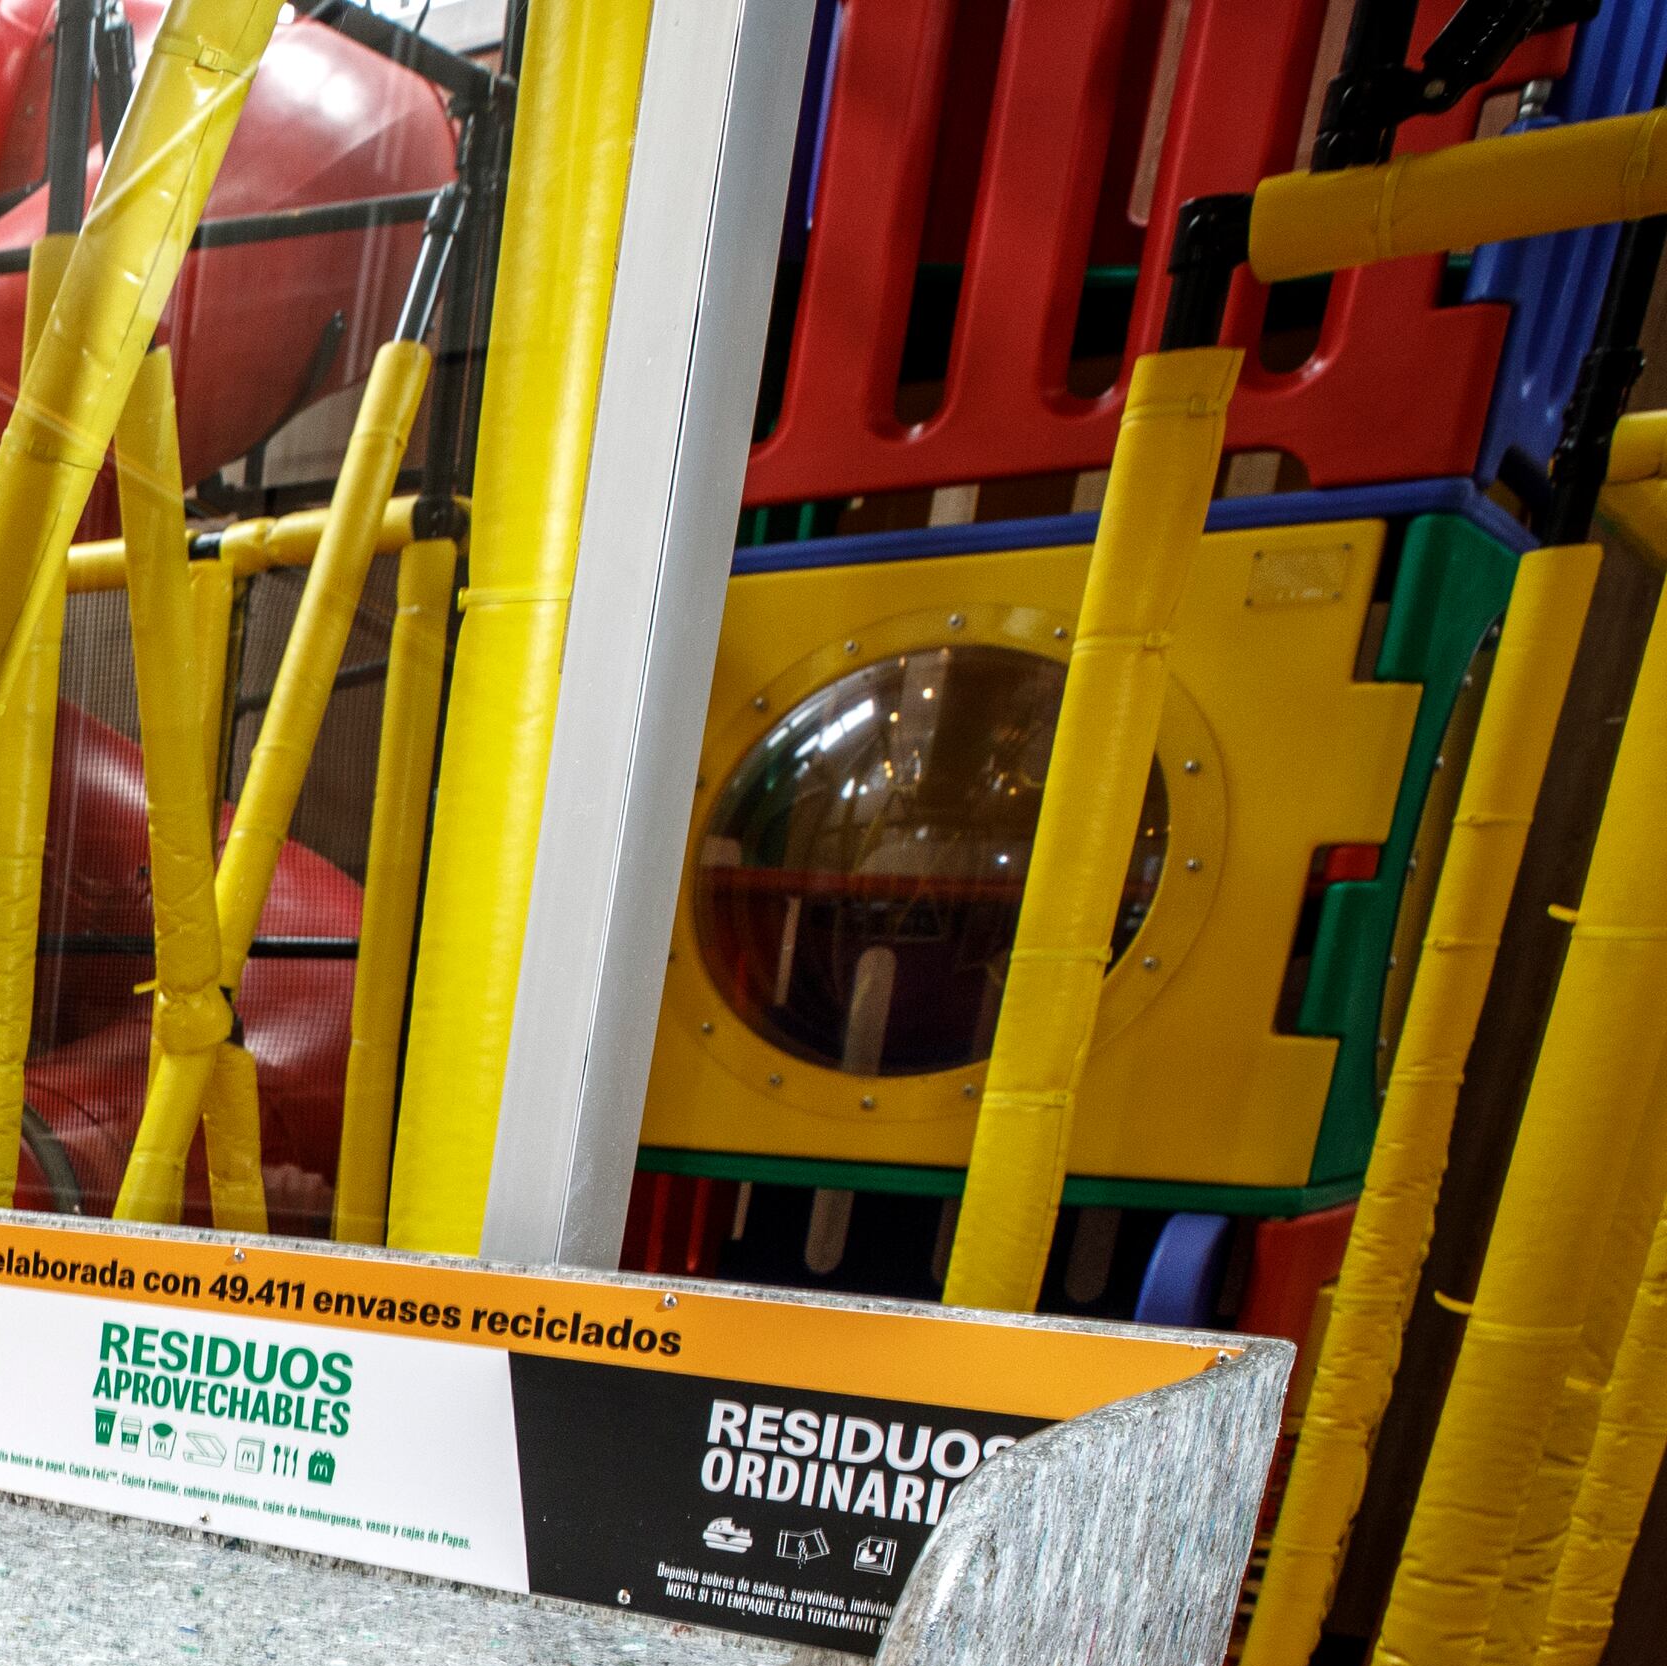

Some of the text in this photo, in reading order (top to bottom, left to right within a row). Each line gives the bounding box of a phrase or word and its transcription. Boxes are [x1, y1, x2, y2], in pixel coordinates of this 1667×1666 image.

[142, 1270, 202, 1298] con
[209, 1273, 306, 1312] 49.411
[313, 1290, 462, 1330] envases
[470, 1304, 682, 1357] reciclados
[99, 1321, 354, 1397] RESIDUOS
[92, 1366, 351, 1439] APROVECHABLES
[10, 1449, 33, 1468] bolsas
[34, 1455, 44, 1470] de
[45, 1458, 67, 1475] papel,
[69, 1463, 91, 1480] Cajita
[148, 1478, 181, 1497] Familiar,
[183, 1484, 220, 1504] cubiertos
[222, 1491, 260, 1512] plásticos,
[262, 1501, 285, 1517] cajas
[287, 1503, 297, 1518] de
[299, 1506, 363, 1531] hamburguesas,
[366, 1520, 391, 1534] vasos
[393, 1525, 399, 1538] y
[401, 1526, 425, 1542] cajas
[428, 1528, 439, 1544] de
[442, 1532, 472, 1551] Papas.
[700, 1447, 963, 1526] ORDINARI
[656, 1561, 699, 1584] Deposita
[701, 1570, 735, 1591] sobres
[737, 1577, 750, 1592] de
[752, 1580, 788, 1601] salsas,
[790, 1588, 847, 1613] servilletas,
[665, 1582, 696, 1601] NOTA:
[697, 1587, 709, 1603] SI
[711, 1589, 725, 1607] TU
[727, 1592, 776, 1617] EMPAQUE
[777, 1602, 803, 1621] ESTÁ
[806, 1608, 876, 1635] TOTALMENTE
